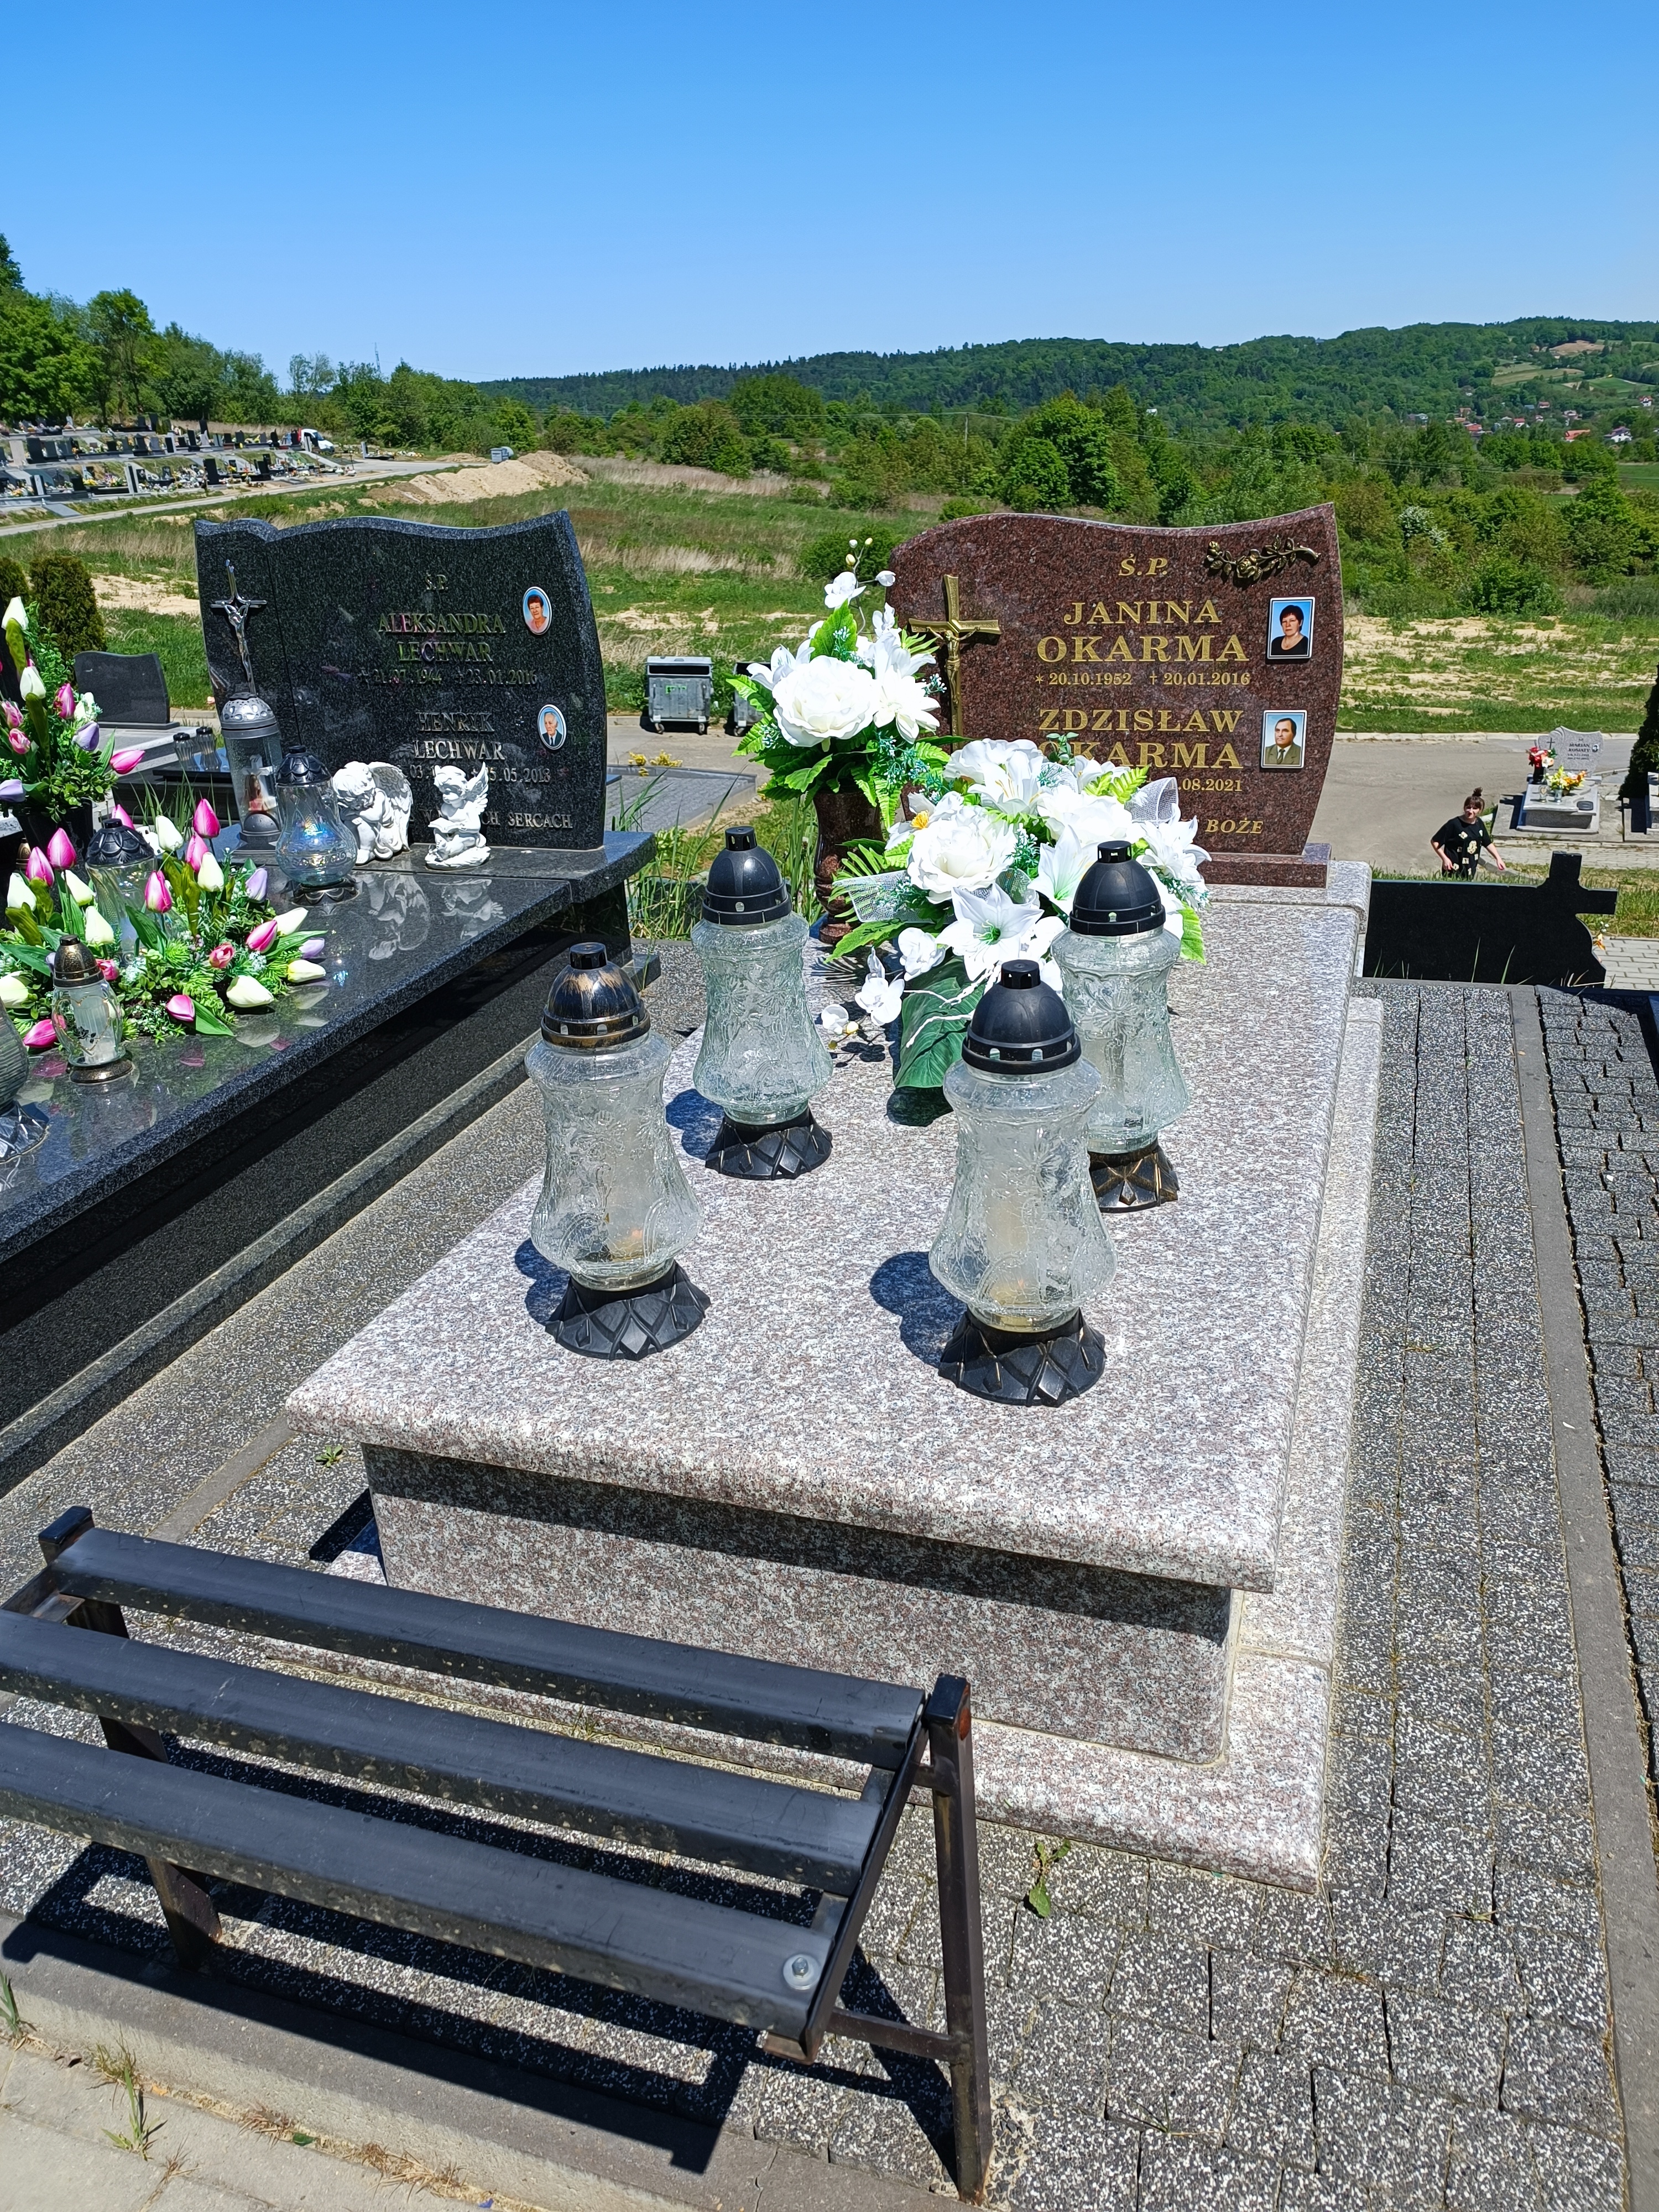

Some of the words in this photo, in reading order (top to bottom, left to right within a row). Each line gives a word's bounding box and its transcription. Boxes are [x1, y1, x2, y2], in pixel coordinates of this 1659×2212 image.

[1118, 554, 1168, 576] Ś.P.
[1063, 599, 1222, 625] JANINA
[378, 613, 506, 634] ALEKSANDRA
[397, 641, 494, 662] LECHWAR
[1036, 634, 1250, 662] OKARMA
[1050, 672, 1132, 686] 20.10.1952
[1164, 672, 1251, 686] 20.01.2016
[415, 712, 495, 733] HENRYK
[1038, 708, 1244, 733] ZDZISŁAW
[413, 740, 505, 761] LECHWAR
[486, 766, 551, 783] 5.05.2018
[1170, 778, 1243, 791] .08.2021
[508, 812, 573, 828] SERCACH
[1204, 817, 1264, 834] BOŻE
